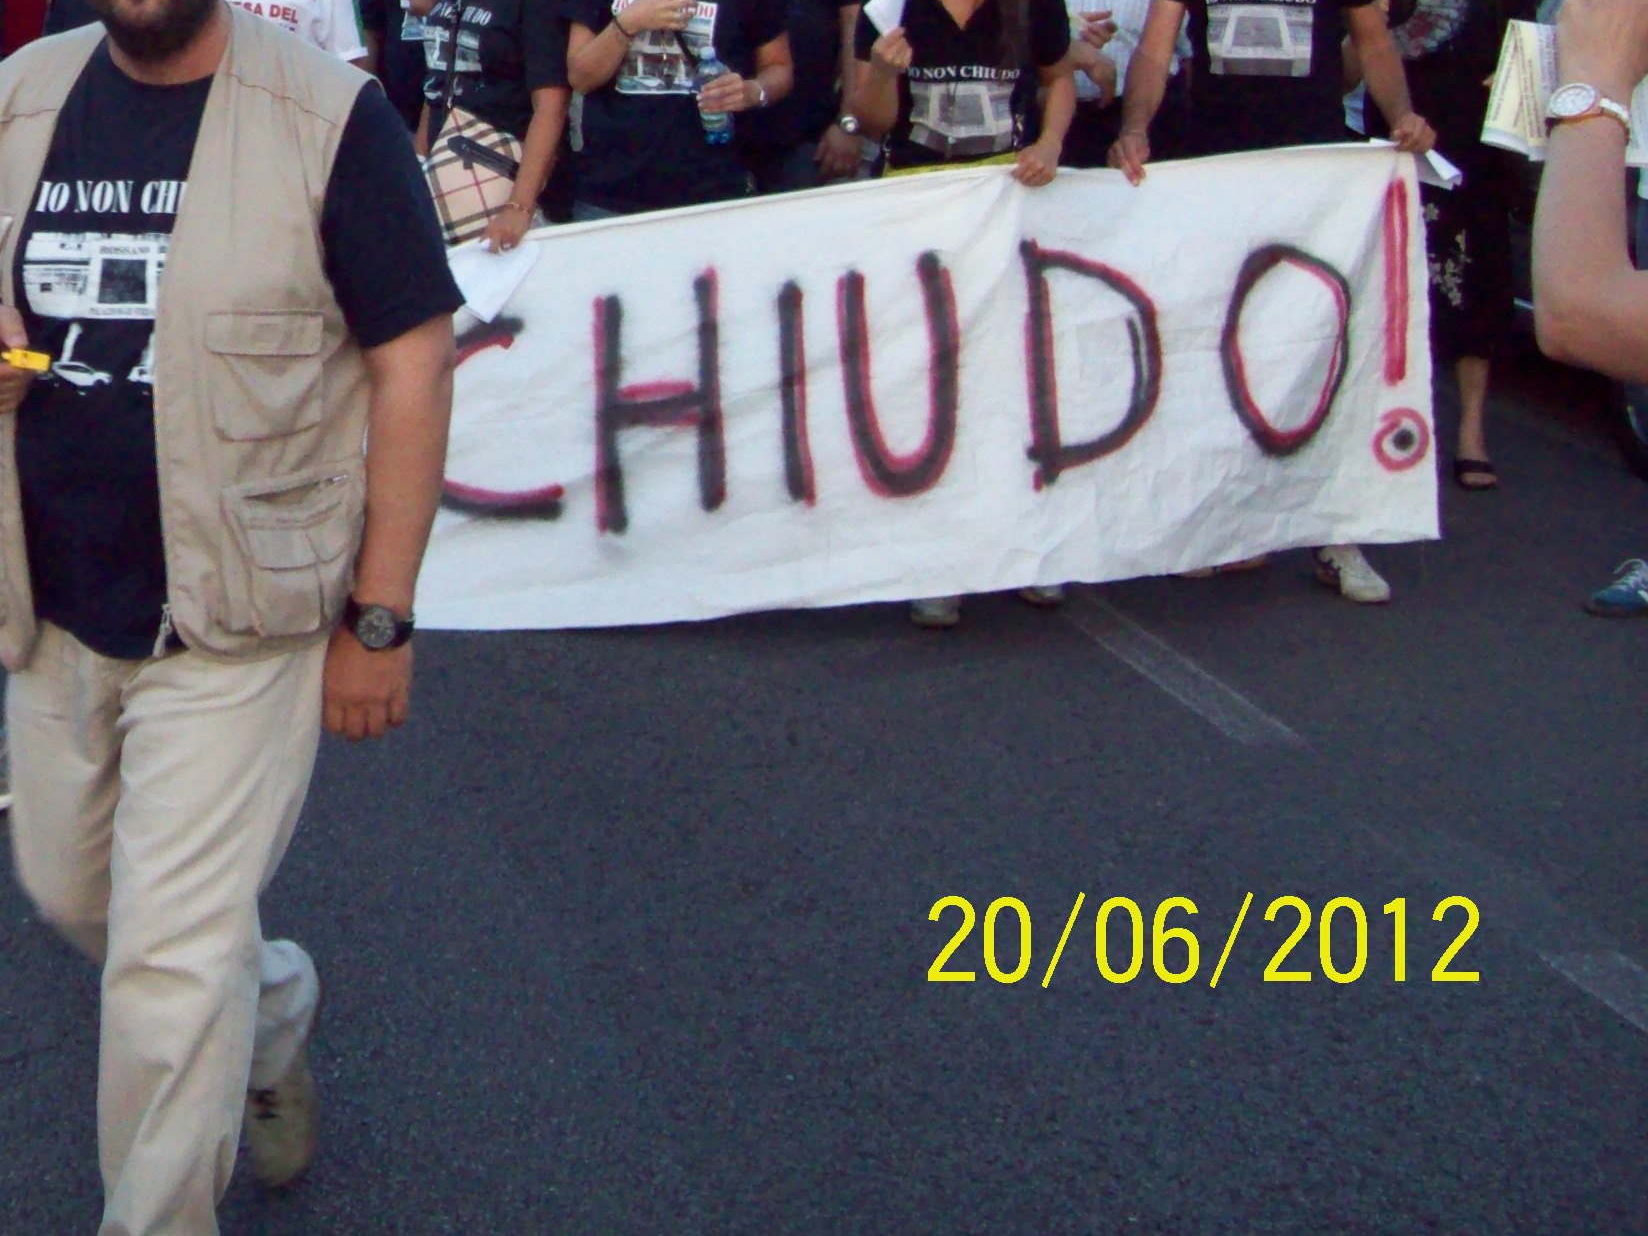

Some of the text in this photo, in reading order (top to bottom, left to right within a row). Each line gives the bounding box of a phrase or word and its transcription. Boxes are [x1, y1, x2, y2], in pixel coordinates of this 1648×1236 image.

[269, 3, 299, 24] DEL
[922, 65, 958, 80] NON
[34, 180, 70, 213] IO
[73, 180, 134, 213] NON
